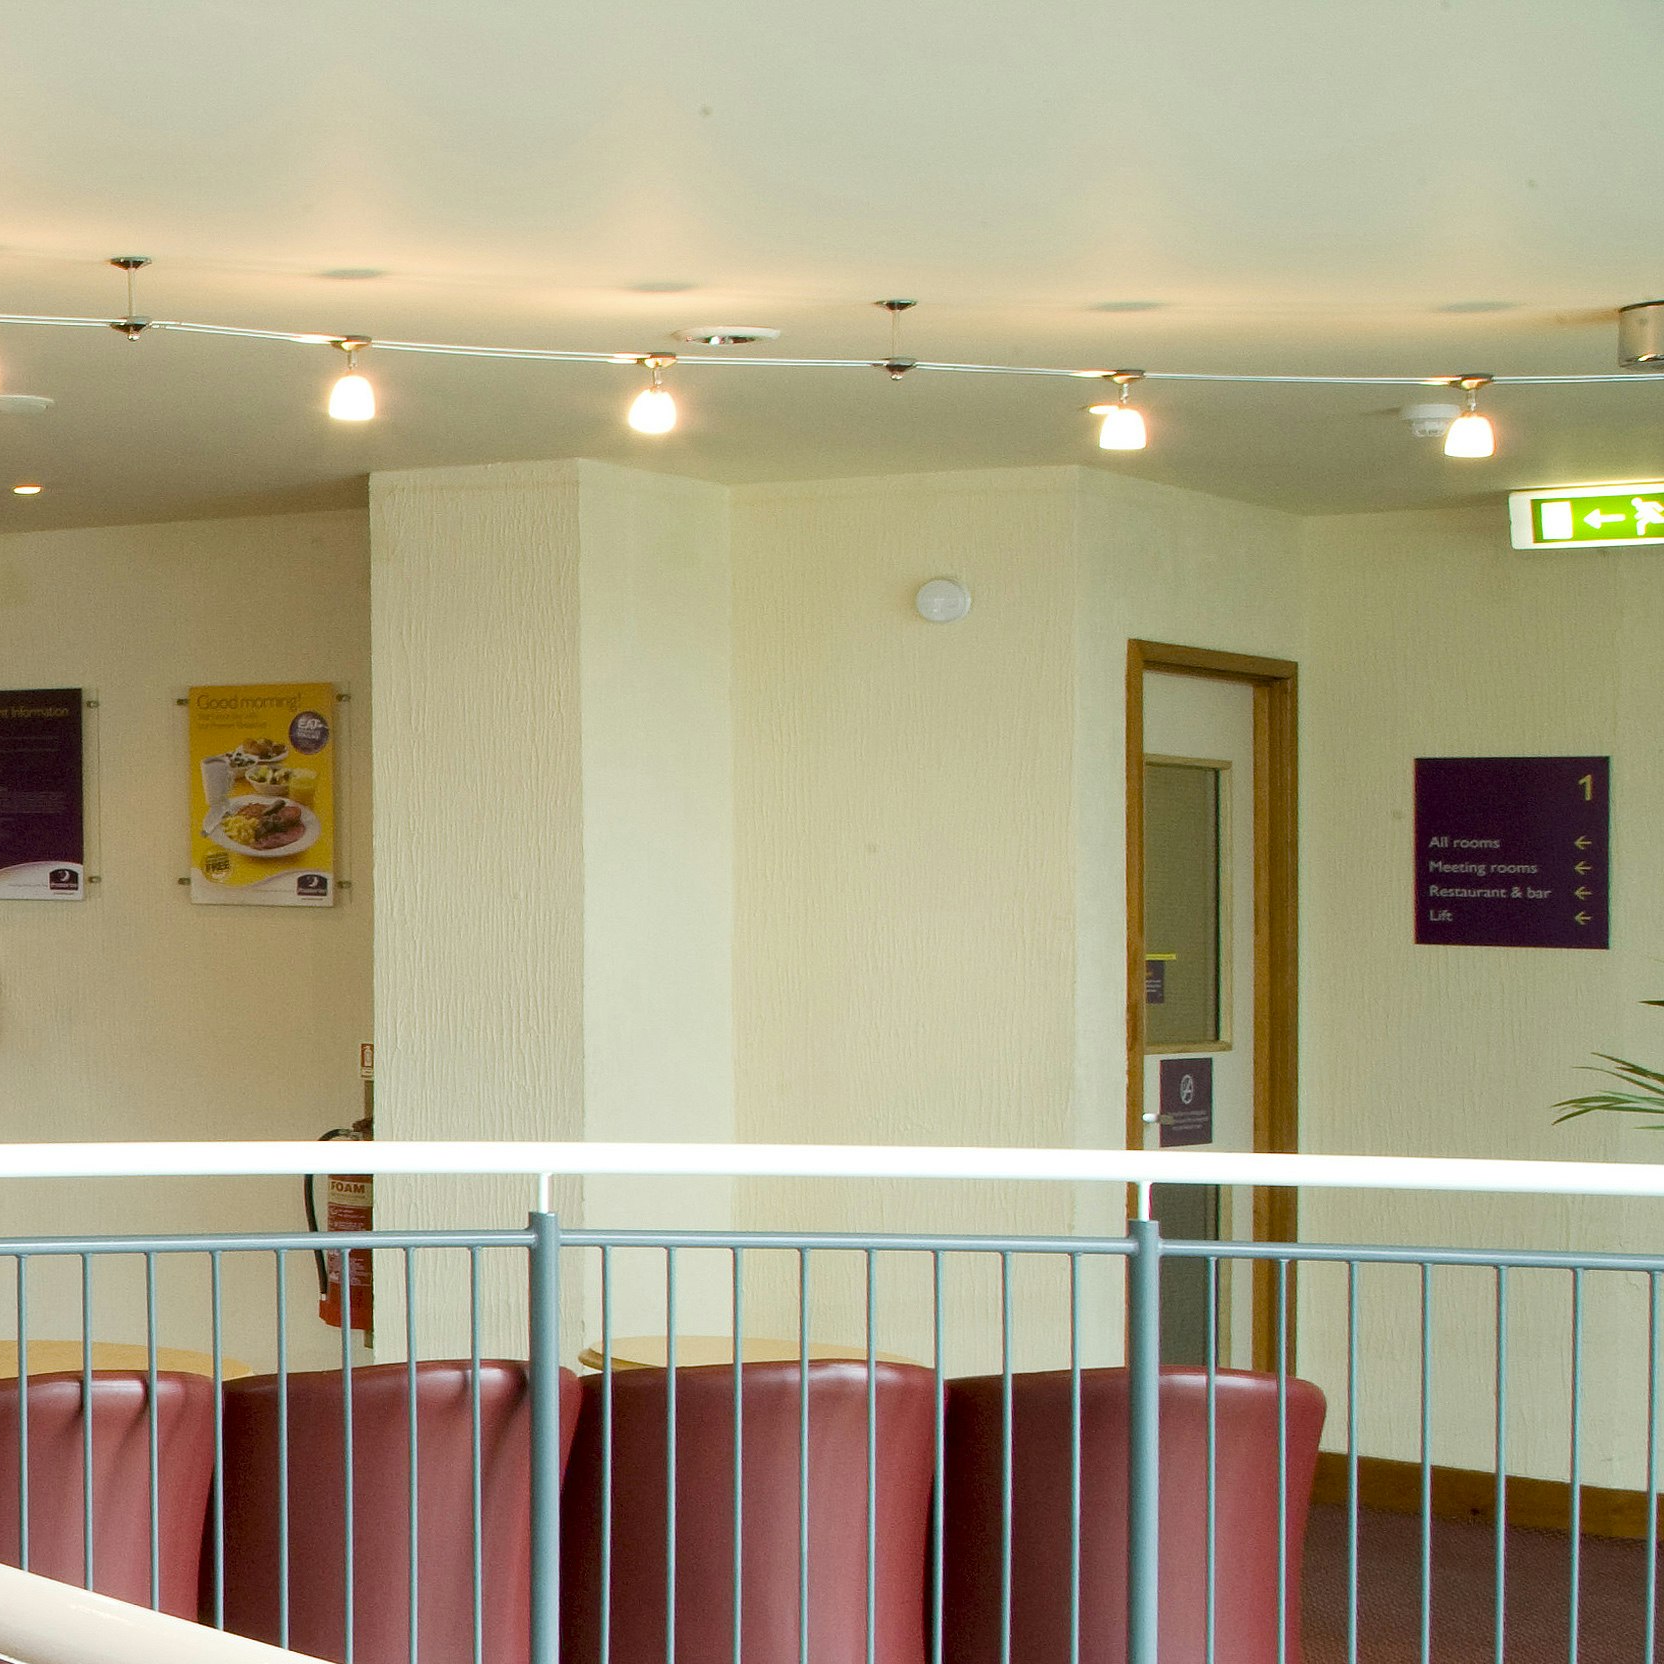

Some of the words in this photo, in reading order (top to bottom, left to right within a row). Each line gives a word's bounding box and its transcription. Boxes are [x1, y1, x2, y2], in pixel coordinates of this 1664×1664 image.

[197, 694, 238, 710] Good
[1578, 774, 1593, 801] 1
[1428, 836, 1449, 848] All
[1453, 839, 1500, 849] rooms
[1429, 860, 1487, 877] Meeting
[1490, 864, 1538, 874] rooms
[1429, 885, 1507, 898] Restaurant
[1510, 886, 1522, 898] &
[1527, 886, 1552, 899] bar
[1429, 909, 1454, 922] Lift
[330, 1181, 366, 1194] FOAM
